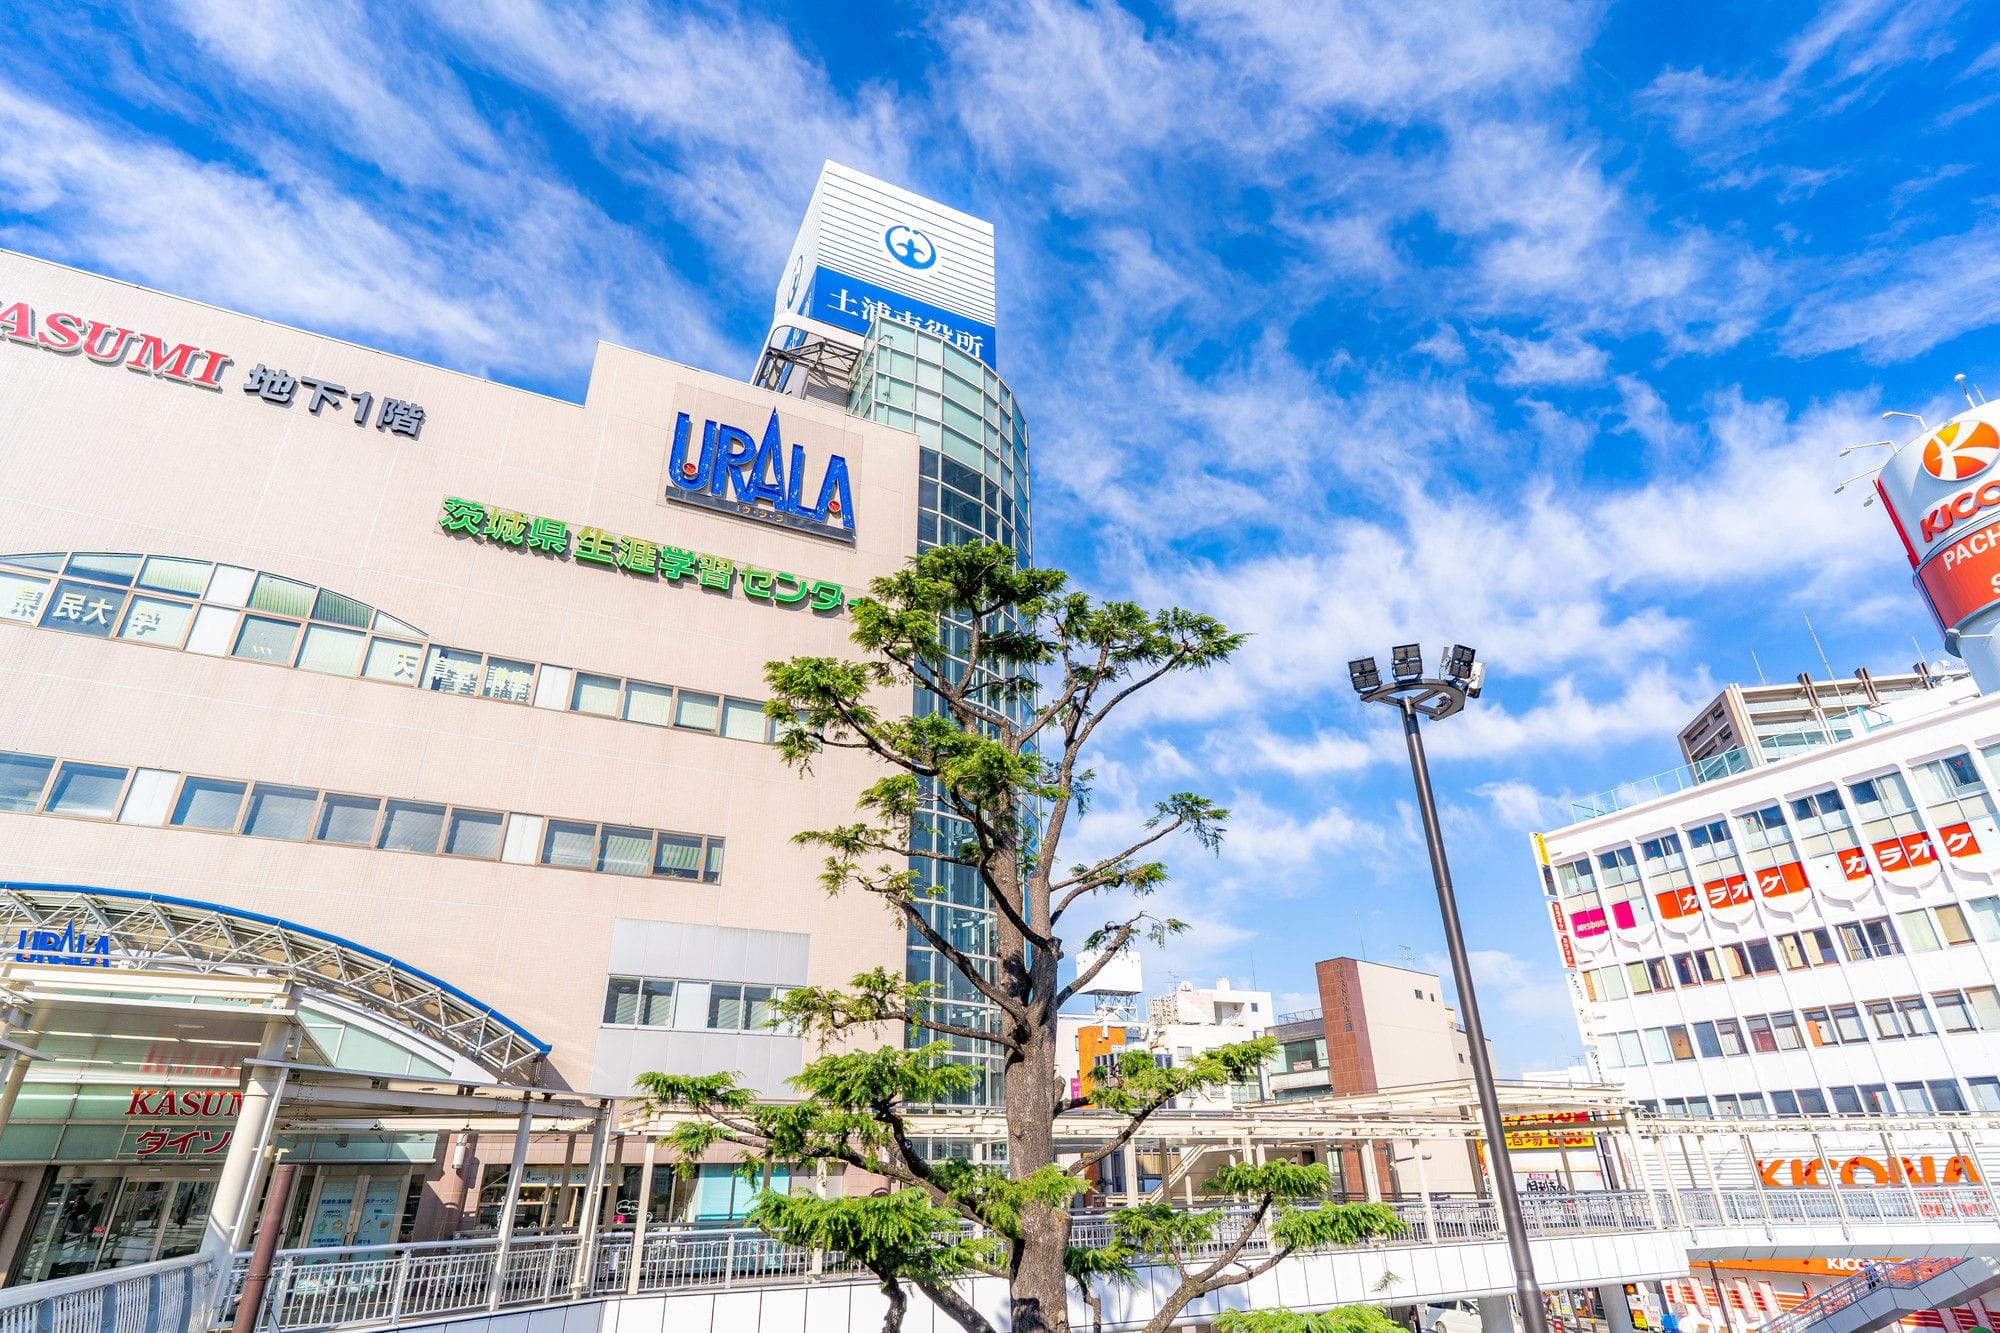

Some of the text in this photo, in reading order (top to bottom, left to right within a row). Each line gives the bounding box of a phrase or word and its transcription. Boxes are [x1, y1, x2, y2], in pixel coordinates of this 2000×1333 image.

[244, 364, 425, 438] 地下1階
[668, 407, 857, 531] URALA
[1844, 821, 1973, 876] カラオケ
[1682, 876, 1782, 912] カラオケ
[16, 918, 110, 967] URALA
[1756, 1156, 1983, 1187] KICONA
